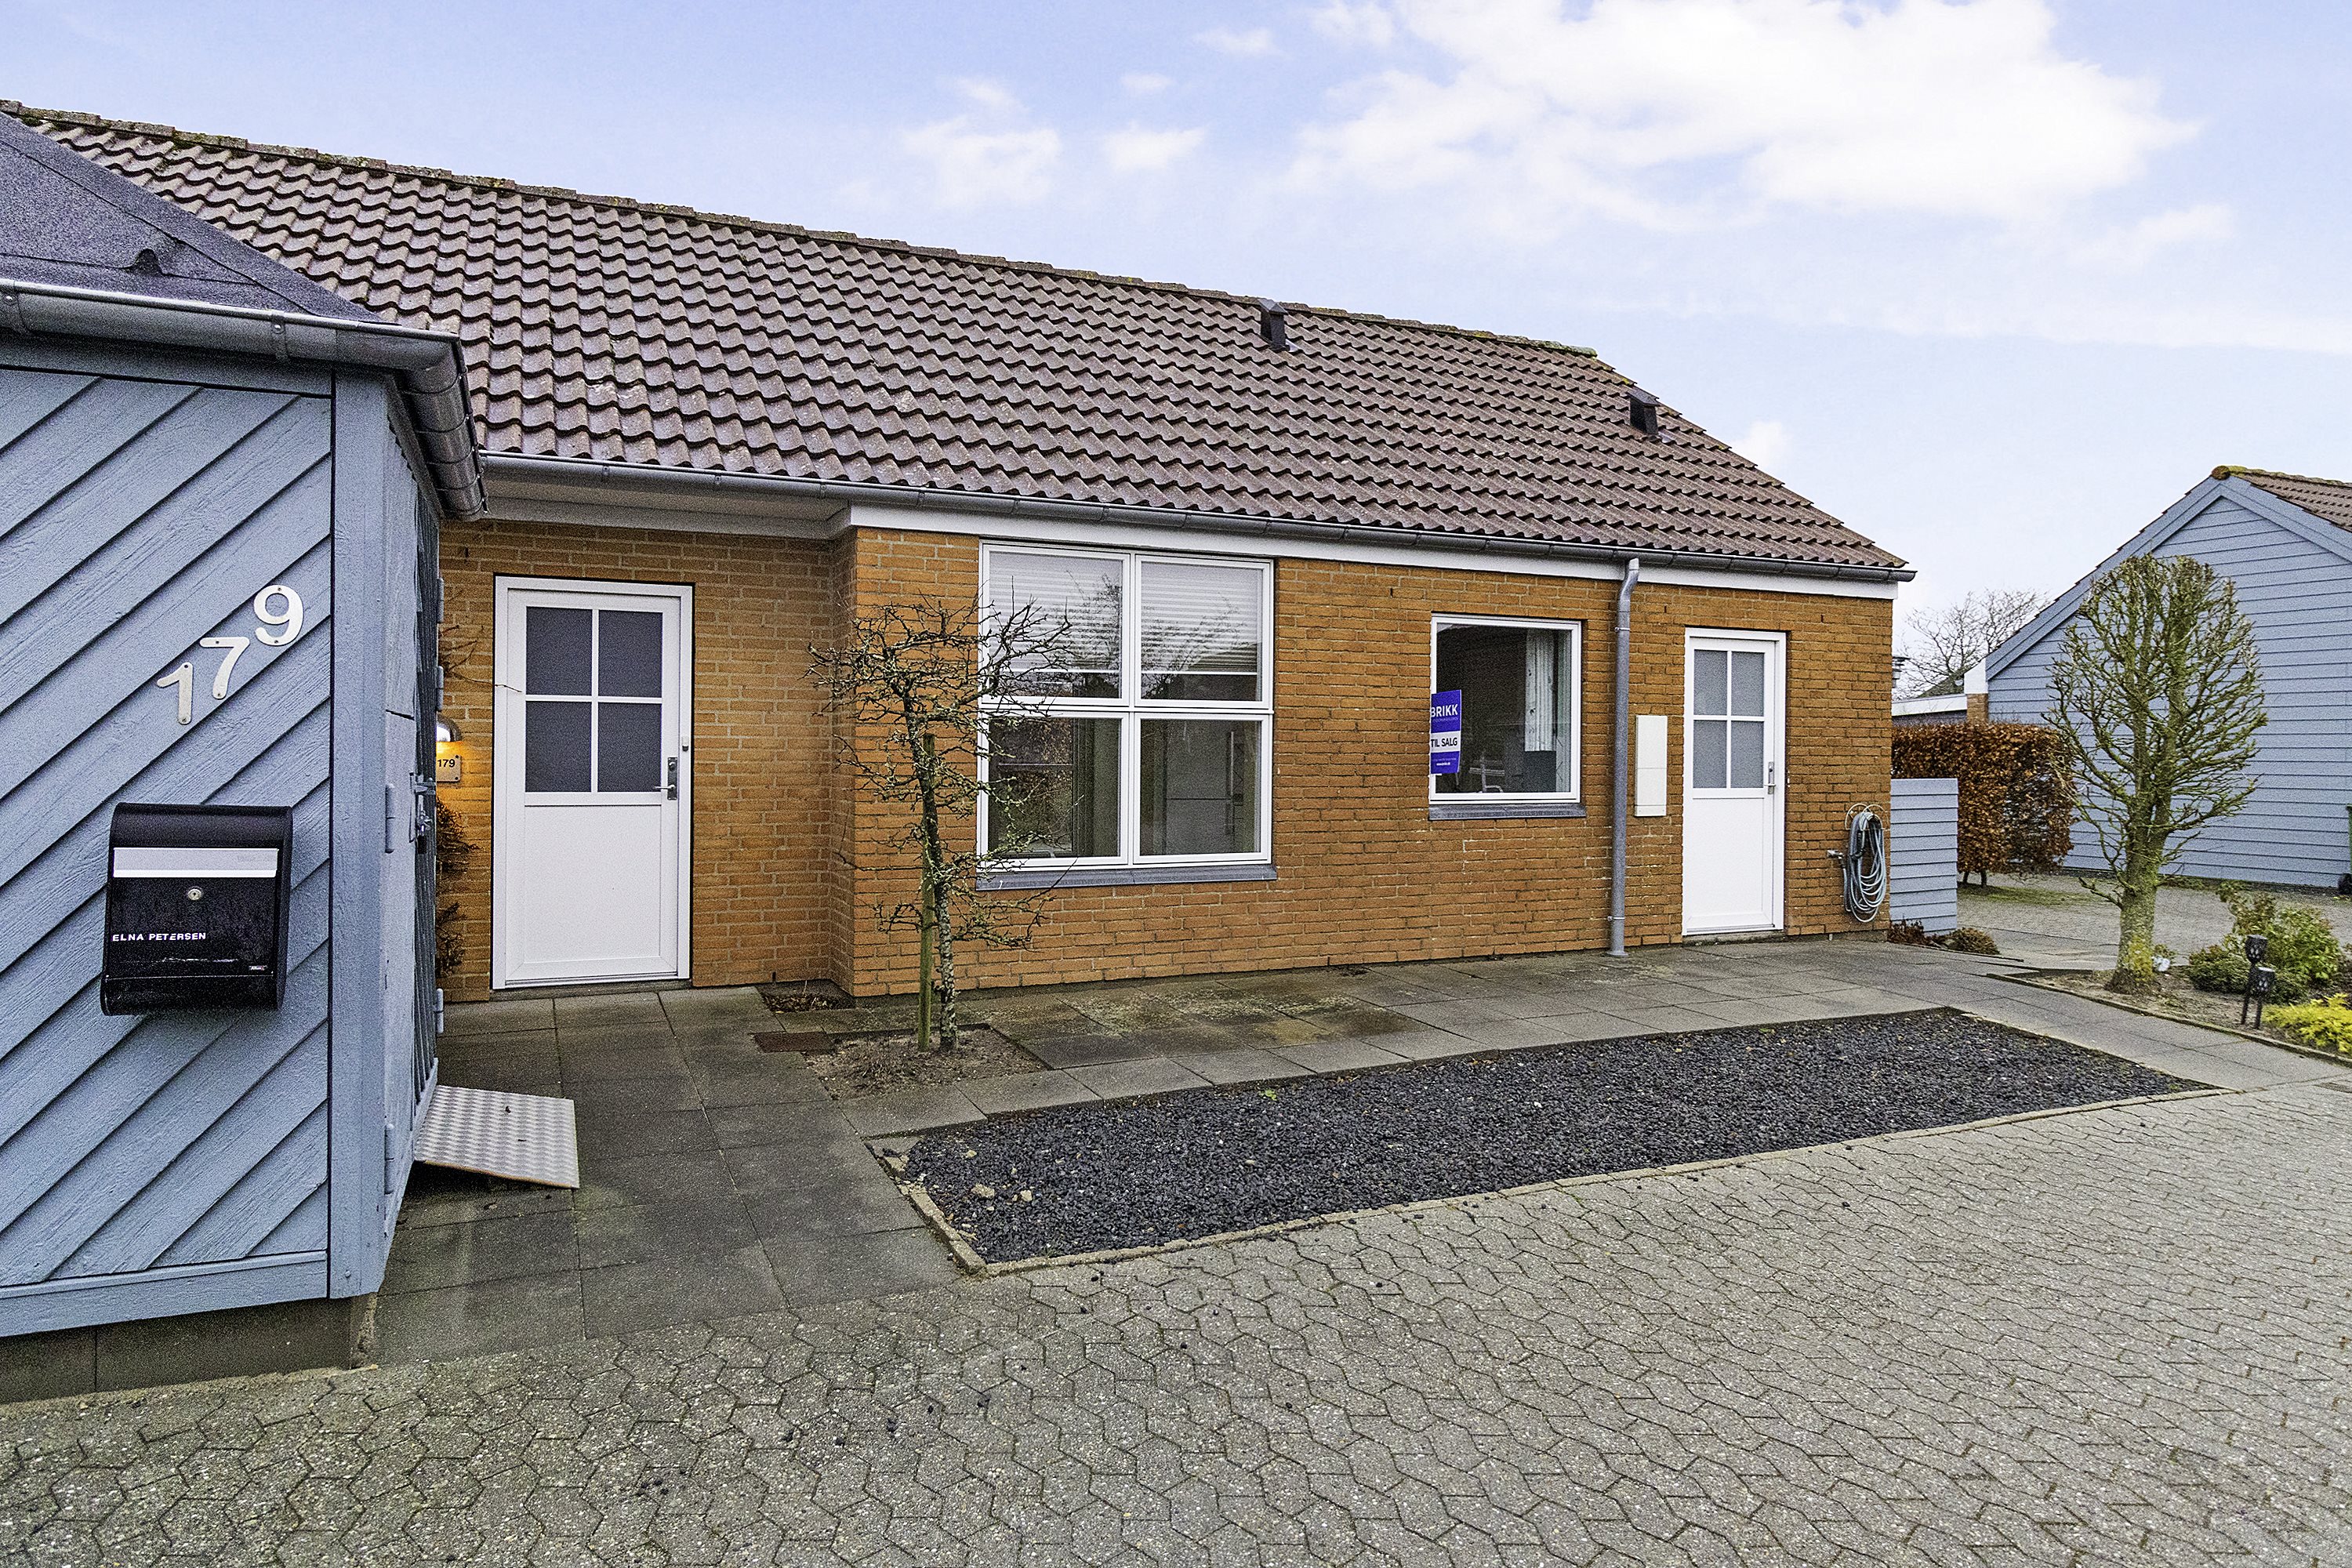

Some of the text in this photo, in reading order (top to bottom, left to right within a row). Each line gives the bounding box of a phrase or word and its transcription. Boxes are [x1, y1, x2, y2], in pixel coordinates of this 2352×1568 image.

[157, 584, 304, 725] 179
[1430, 704, 1458, 717] BRIKK
[1431, 737, 1458, 748] TIL SALG
[437, 758, 456, 768] 179
[112, 932, 206, 942] ELNA PETERSEN
